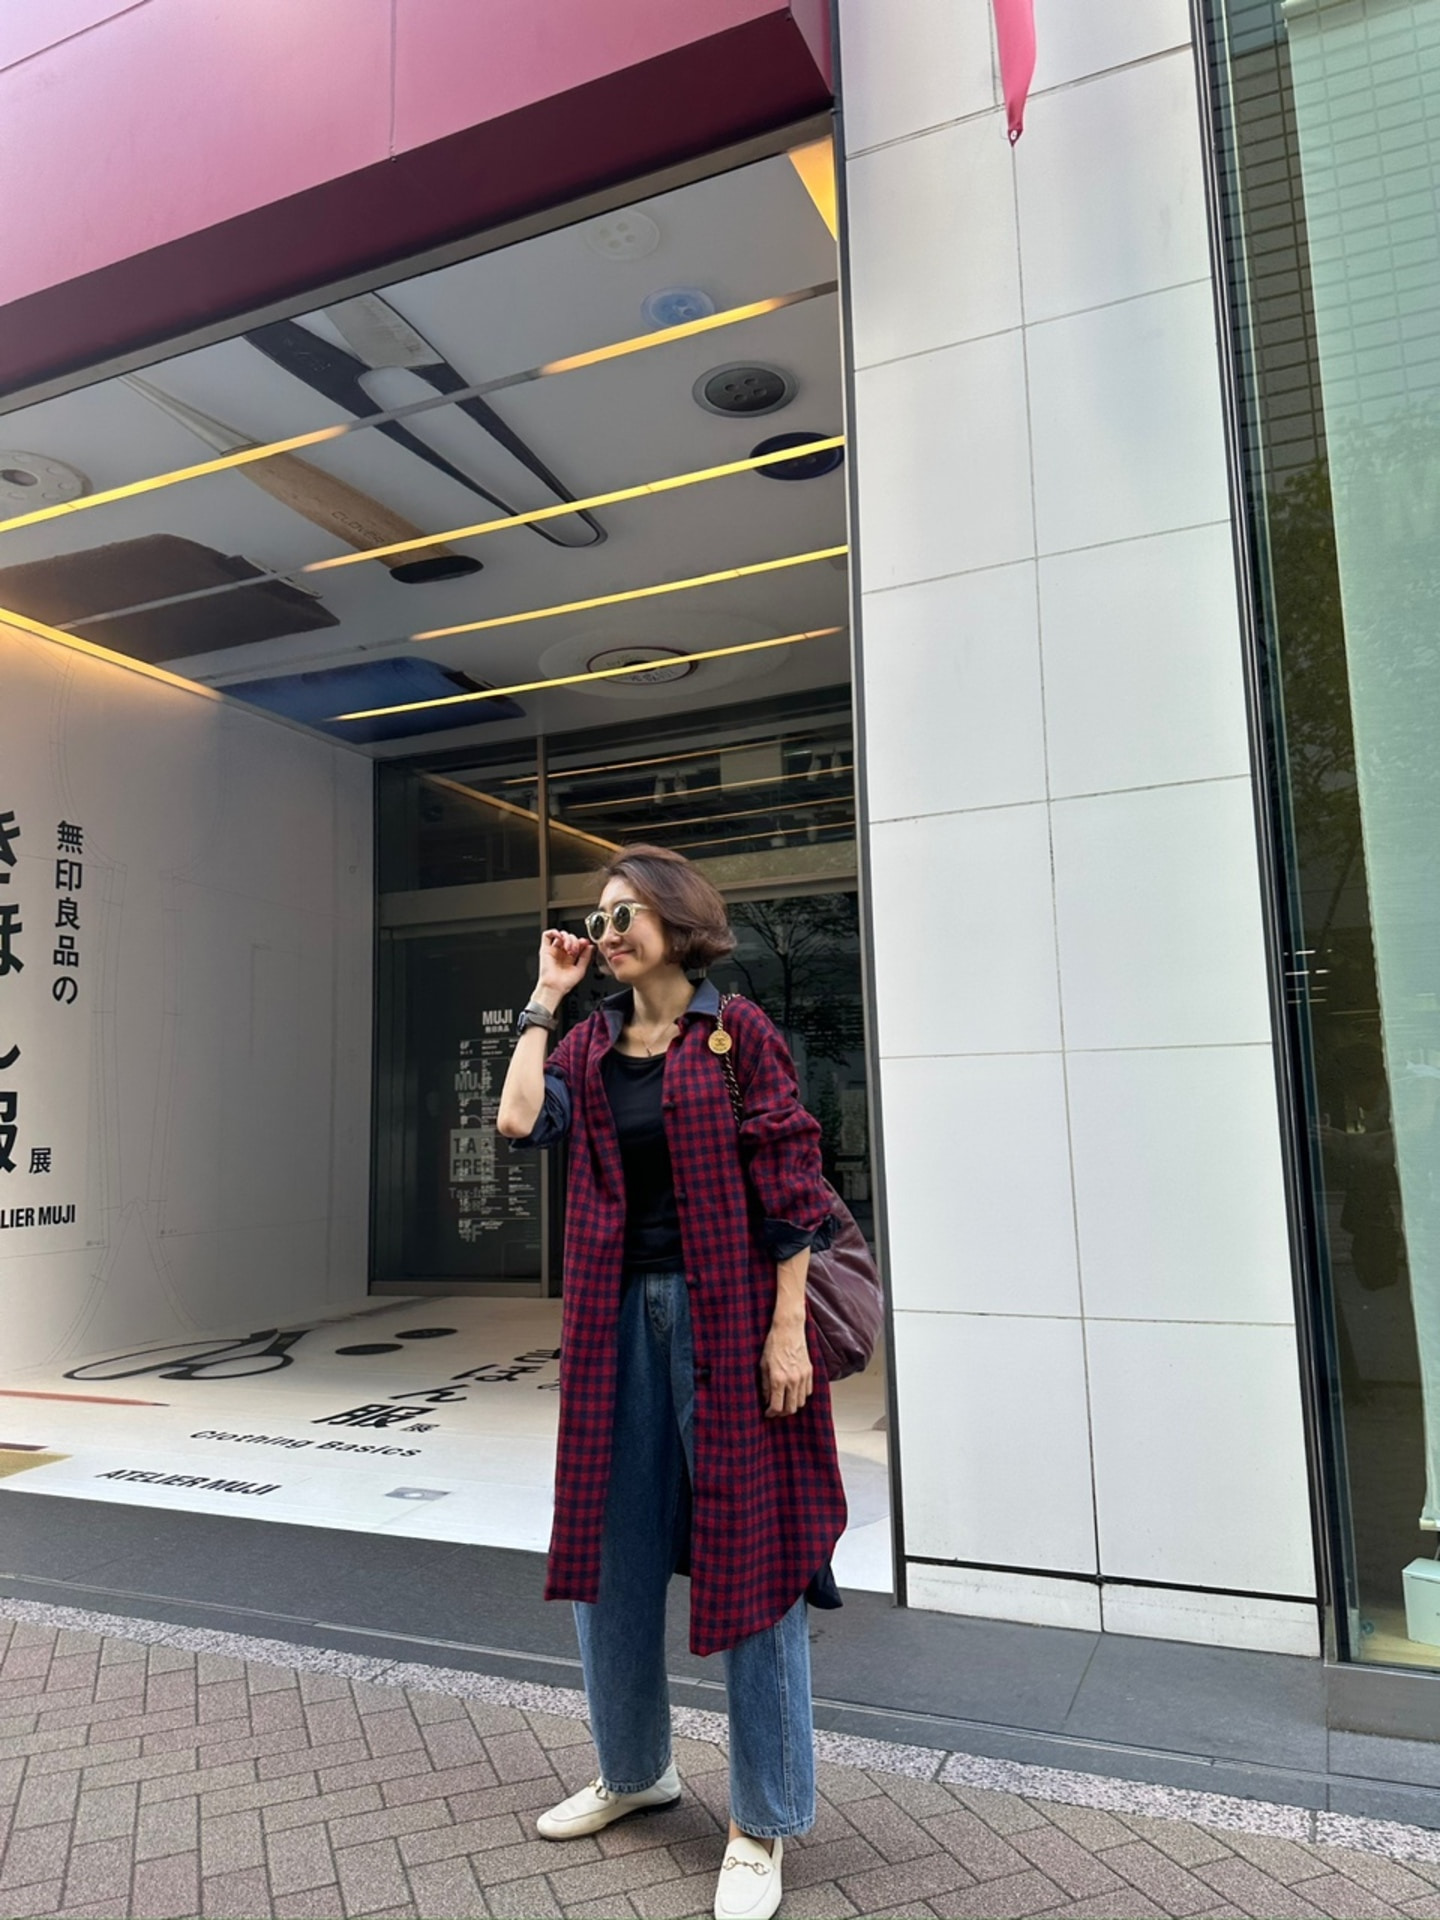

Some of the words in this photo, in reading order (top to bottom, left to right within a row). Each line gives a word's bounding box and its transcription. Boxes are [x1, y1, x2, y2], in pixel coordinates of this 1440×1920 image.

[52, 819, 84, 1005] 無印良品の
[482, 1009, 513, 1026] MUJI
[29, 1147, 52, 1174] 展
[38, 1204, 76, 1226] MUJI
[190, 1429, 314, 1449] Clothing
[315, 1440, 422, 1457] Basics
[95, 1469, 210, 1488] ATELIER
[200, 1479, 282, 1496] MUJI
